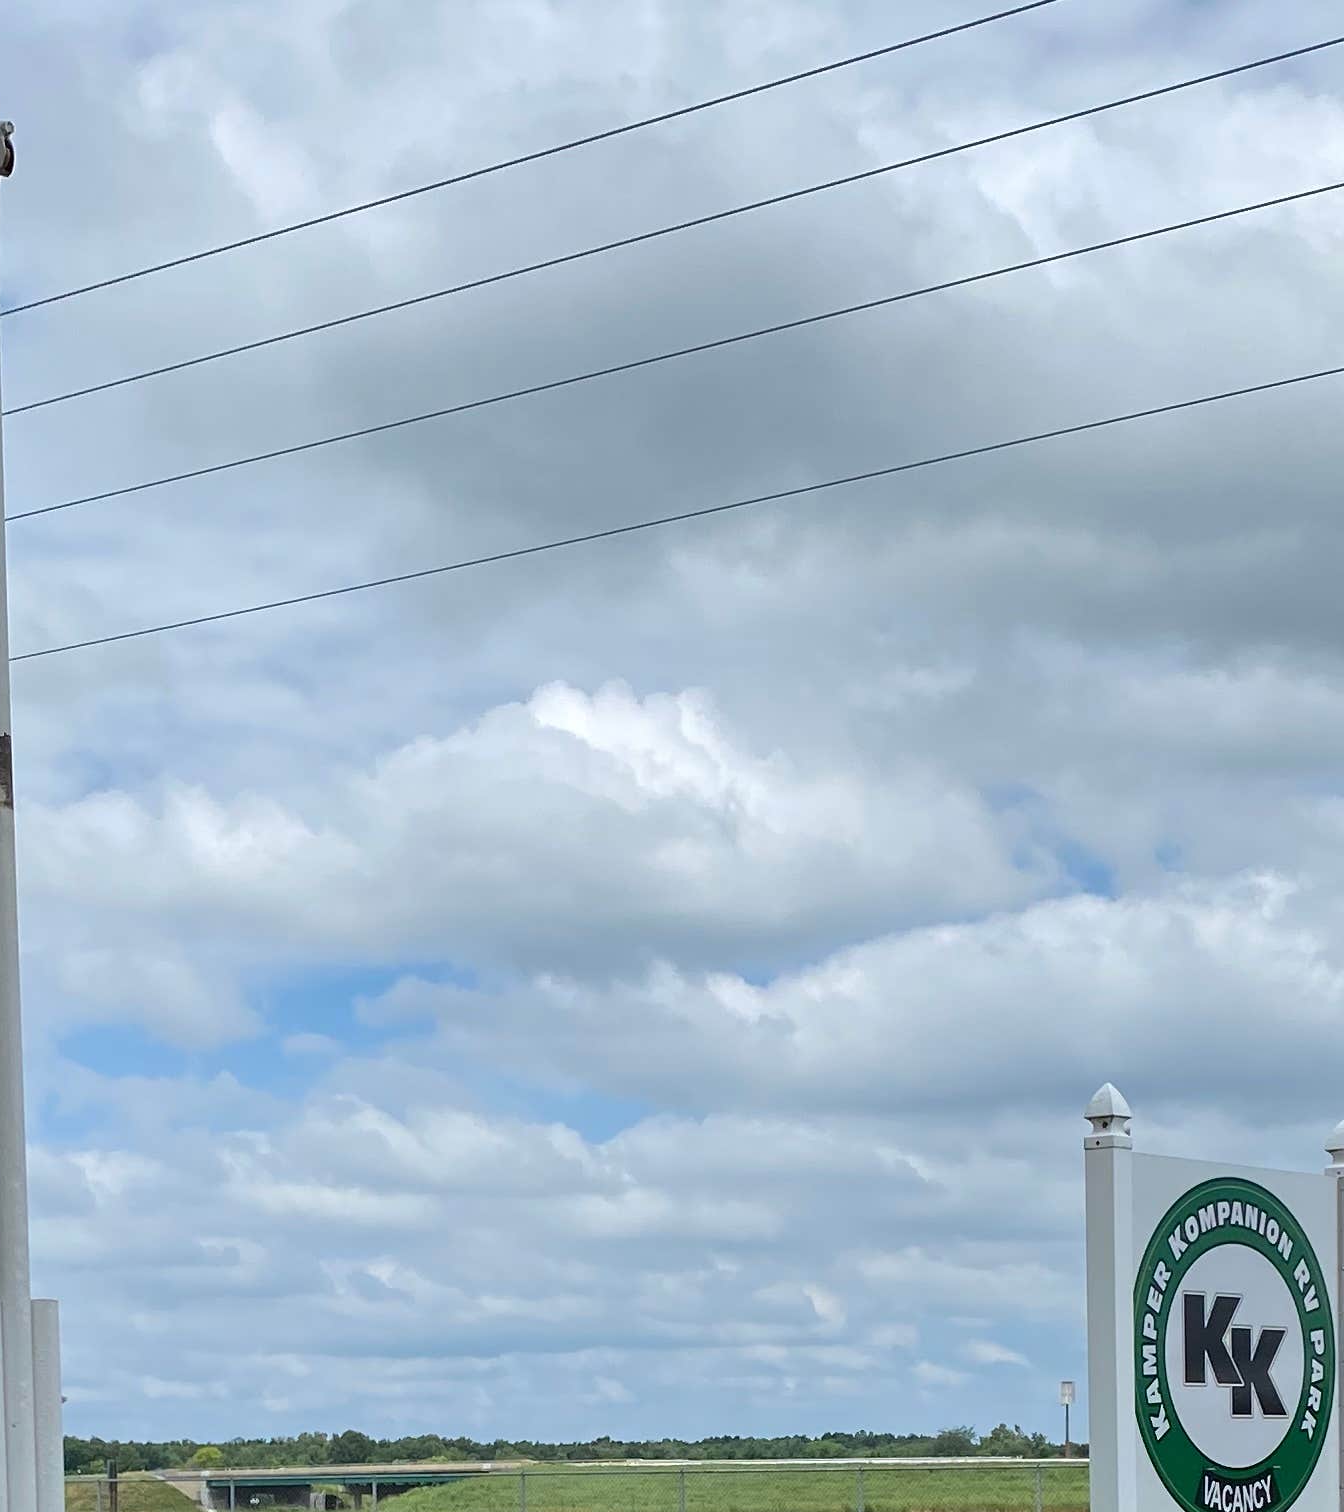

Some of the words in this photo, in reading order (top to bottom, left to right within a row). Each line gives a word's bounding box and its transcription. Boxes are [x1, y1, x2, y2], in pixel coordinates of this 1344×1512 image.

[1168, 1201, 1293, 1261] KOMPANION
[1293, 1258, 1320, 1312] RV
[1142, 1260, 1171, 1441] KAMPER
[1301, 1329, 1325, 1440] PARK
[1204, 1475, 1272, 1512] VACANCY
